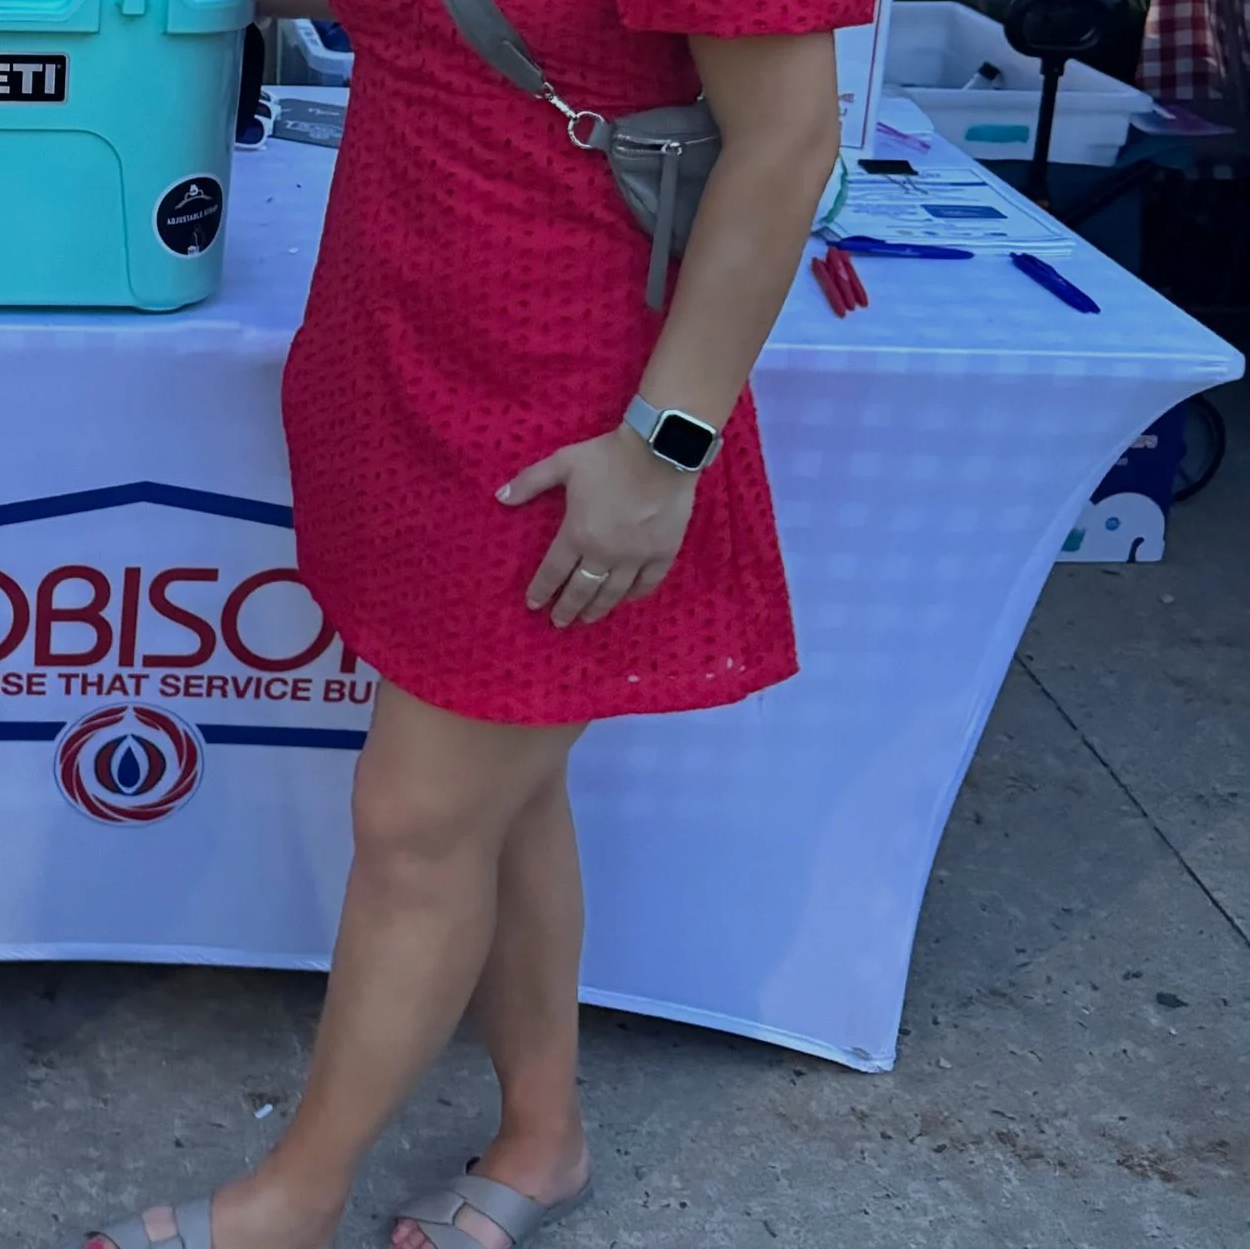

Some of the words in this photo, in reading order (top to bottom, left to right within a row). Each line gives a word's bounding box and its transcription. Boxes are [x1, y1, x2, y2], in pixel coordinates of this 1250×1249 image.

[57, 672, 150, 698] THAT
[158, 673, 312, 703] SERVICE
[322, 679, 378, 705] BU
